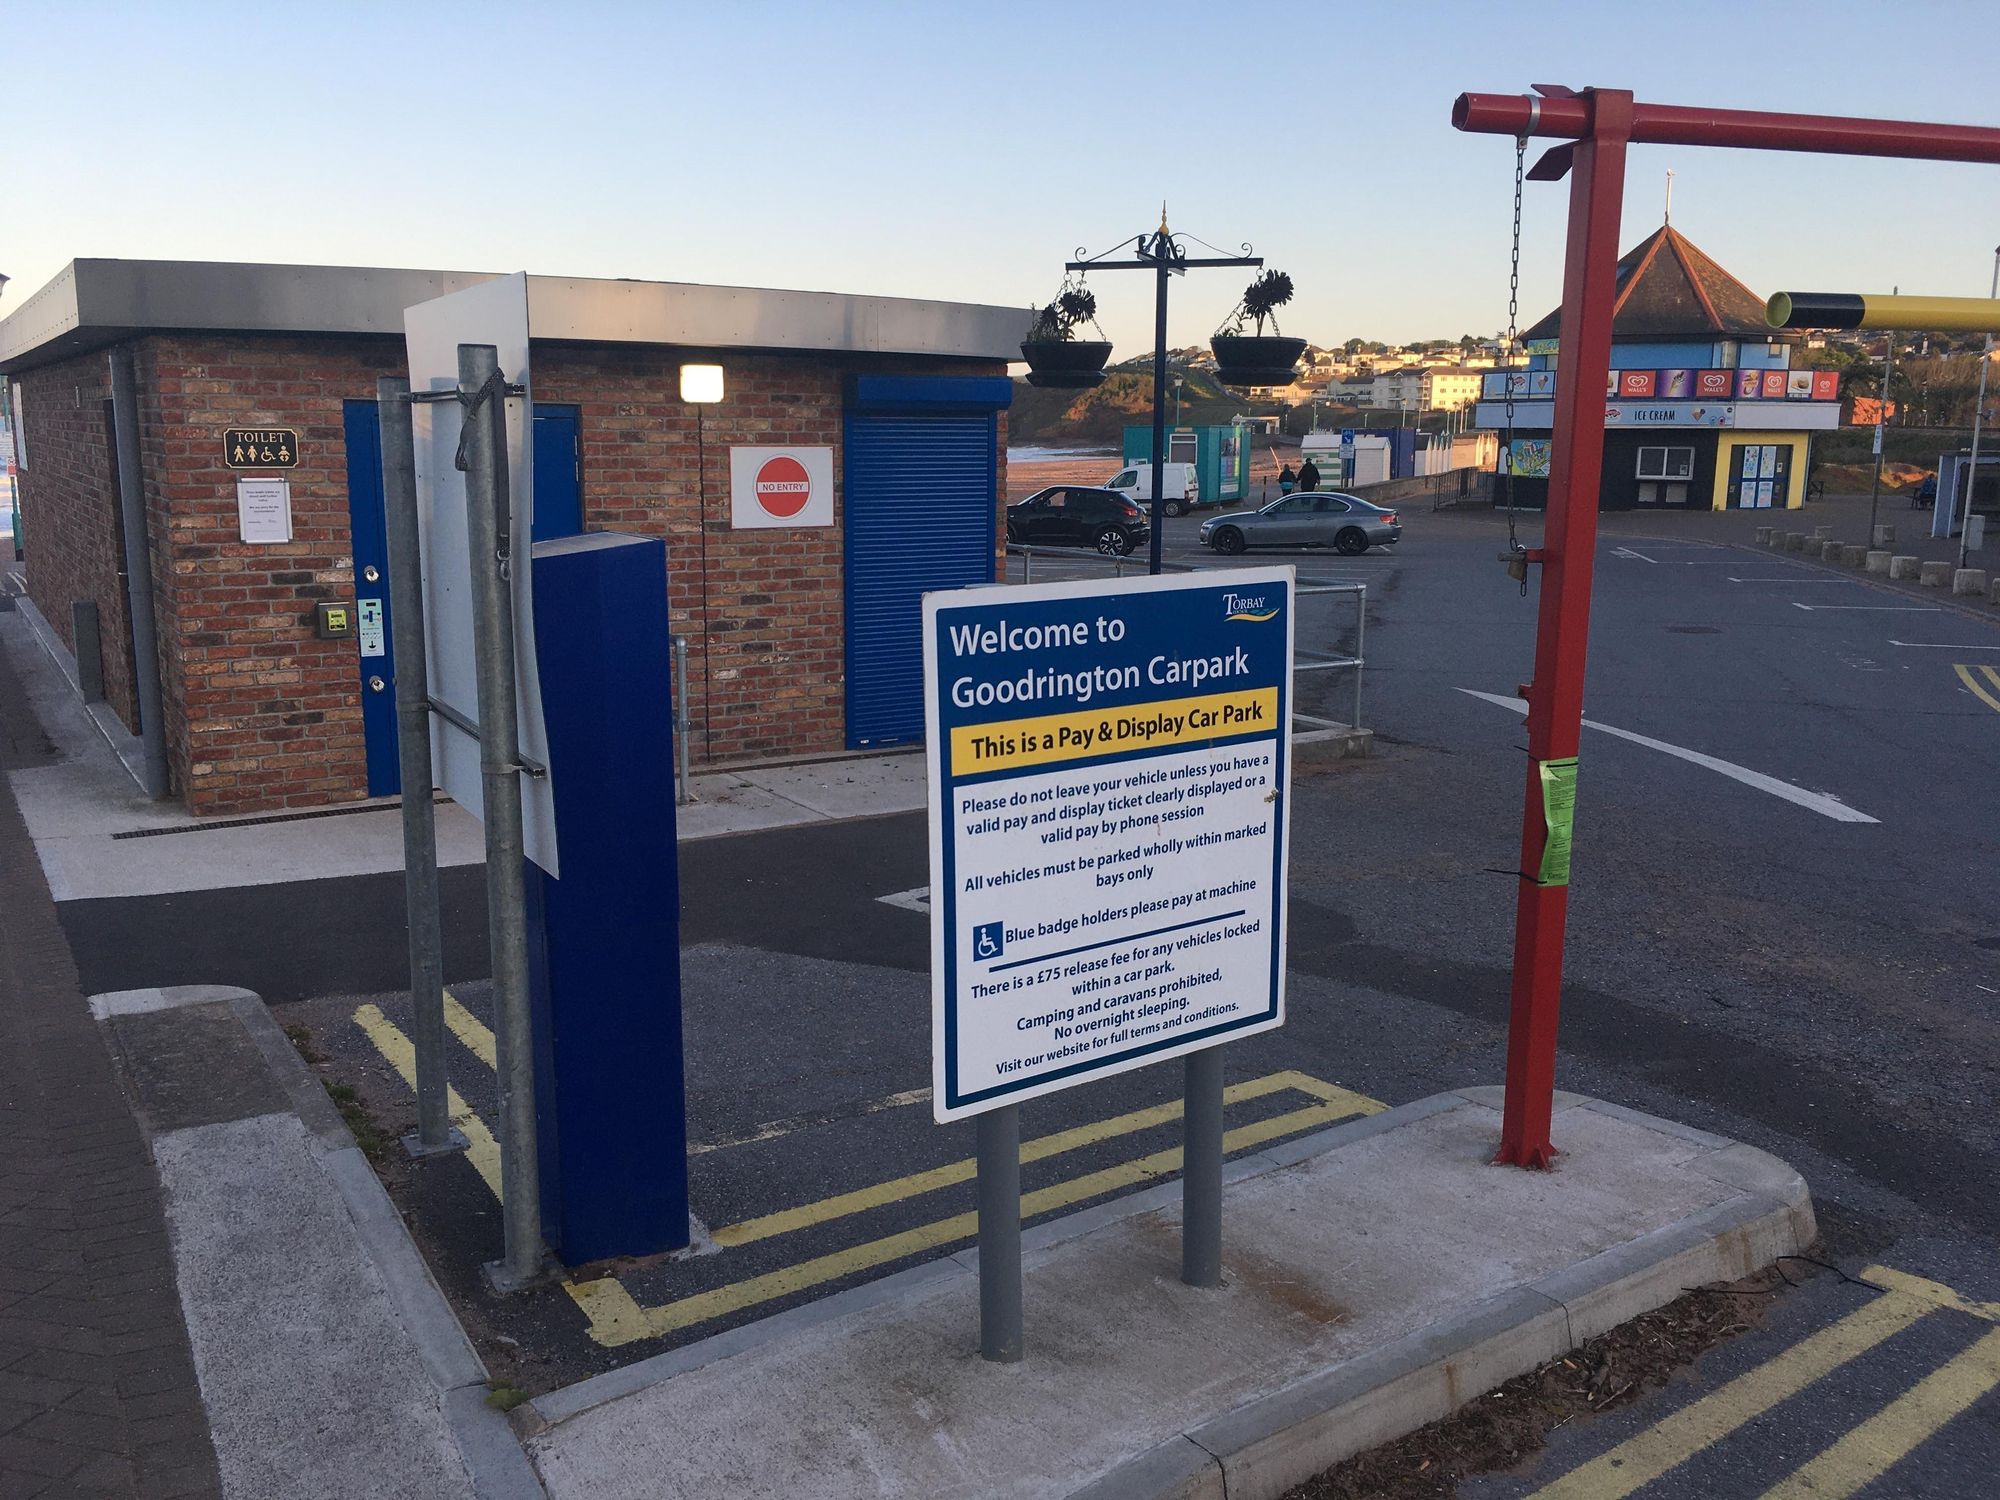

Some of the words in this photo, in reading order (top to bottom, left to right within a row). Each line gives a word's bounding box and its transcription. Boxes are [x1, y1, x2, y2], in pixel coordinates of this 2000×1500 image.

[235, 432, 286, 443] TOILET
[1634, 410, 1647, 421] ICE
[1650, 410, 1675, 421] CREAM
[762, 483, 776, 491] NO
[777, 483, 804, 491] ENTRY
[1223, 593, 1265, 615] TORBAY
[950, 620, 1088, 656] Welcome
[1096, 616, 1125, 642] to
[952, 666, 1139, 707] Goodrington
[1148, 646, 1249, 687] Carpark
[971, 735, 1015, 759] This
[1022, 732, 1037, 752] is
[1043, 734, 1053, 749] a
[1059, 727, 1094, 750] Pay
[1098, 722, 1112, 741] &
[1117, 713, 1184, 740] Display
[1189, 709, 1218, 728] Car
[1224, 701, 1262, 724] Park
[963, 798, 1006, 814] Please
[1010, 792, 1027, 806] do
[1031, 789, 1053, 803] not
[1057, 785, 1089, 798] leave
[1093, 779, 1121, 796] your
[1125, 770, 1167, 787] vehicle
[1170, 765, 1207, 780] unless
[1210, 762, 1230, 777] you
[1234, 757, 1260, 769] have
[1263, 756, 1268, 765] a
[967, 817, 999, 835] valid
[1004, 816, 1028, 832] pay
[1031, 808, 1055, 824] and
[1059, 802, 1105, 820] display
[1108, 795, 1142, 811] ticket
[1145, 787, 1184, 804] clearly
[1187, 776, 1242, 798] displayed
[1245, 777, 1257, 787] or
[1259, 776, 1265, 785] a
[1041, 826, 1072, 843] valid
[1076, 825, 1099, 841] pay
[1102, 820, 1117, 835] by
[1120, 815, 1158, 833] phone
[1162, 806, 1204, 822] session
[965, 876, 982, 892] All
[987, 867, 1040, 887] vehicles
[1044, 860, 1075, 876] must
[1079, 857, 1094, 869] be
[1098, 846, 1140, 869] parked
[1144, 839, 1183, 856] wholly
[1186, 832, 1221, 848] within
[1225, 822, 1266, 841] marked
[1097, 873, 1124, 887] bays
[1127, 865, 1153, 880] only
[1006, 928, 1034, 943] Blue
[1038, 919, 1078, 936] badge
[1082, 908, 1128, 926] holders
[1131, 899, 1169, 919] please
[1172, 894, 1193, 910] pay
[1196, 890, 1207, 901] at
[1210, 880, 1256, 898] machine
[971, 982, 1009, 998] There
[1014, 978, 1023, 989] is
[1027, 976, 1033, 986] a
[1037, 967, 1060, 983] £75
[1064, 959, 1108, 979] release
[1111, 953, 1129, 966] fee
[1133, 948, 1150, 960] for
[1153, 943, 1173, 956] any
[1176, 931, 1221, 950] vehicles
[1224, 919, 1259, 938] locked
[1072, 976, 1110, 995] within
[1114, 976, 1120, 985] a
[1124, 970, 1142, 982] car
[1145, 960, 1174, 980] park.
[1017, 1009, 1074, 1032] Camping
[1078, 999, 1100, 1015] and
[1104, 987, 1156, 1009] caravans
[1159, 967, 1222, 996] prohibited,
[1055, 1026, 1072, 1040] No
[1075, 1009, 1134, 1036] overnight
[1138, 998, 1189, 1019] sleeping.
[996, 1059, 1021, 1074] Visit
[1025, 1055, 1044, 1067] our
[1047, 1042, 1090, 1061] website
[1092, 1037, 1108, 1048] for
[1110, 1029, 1128, 1044] full
[1131, 1023, 1160, 1038] terms
[1163, 1016, 1182, 1030] and
[1184, 1002, 1239, 1023] conditions.
